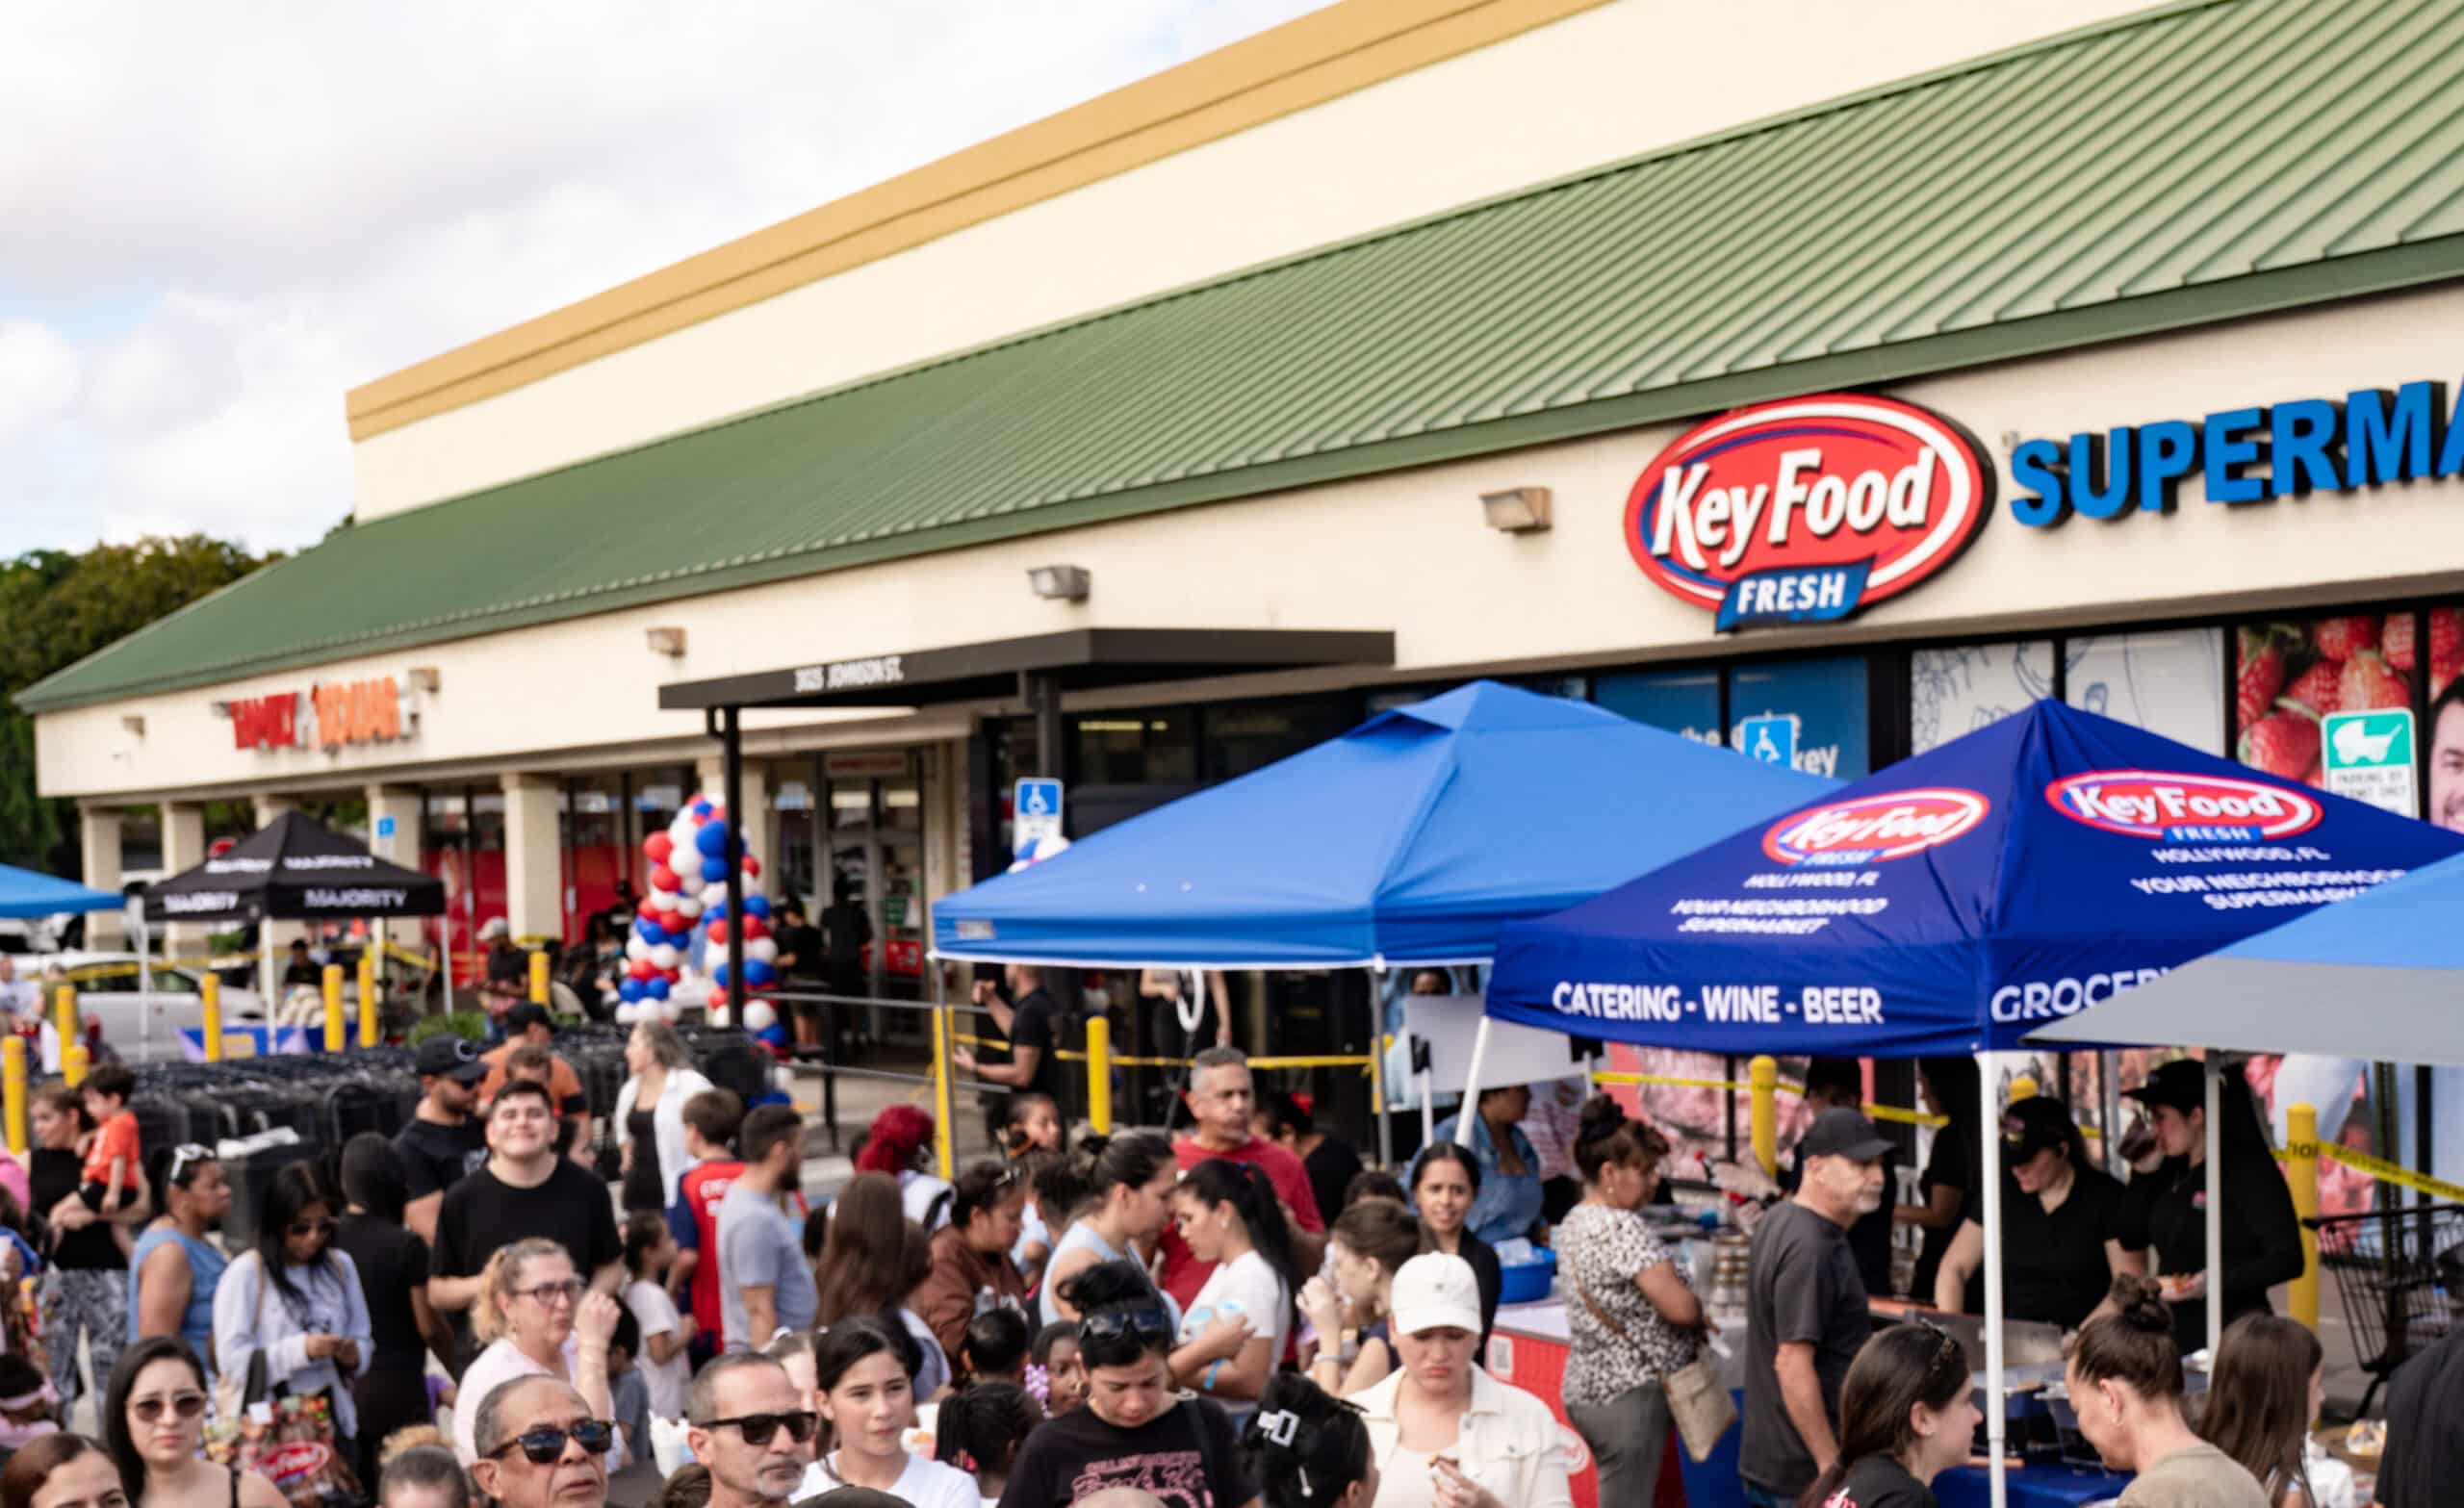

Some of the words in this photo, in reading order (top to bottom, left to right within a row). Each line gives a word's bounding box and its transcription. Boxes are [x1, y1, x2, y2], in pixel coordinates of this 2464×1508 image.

[1651, 462, 1770, 571] Key
[1767, 447, 1937, 546] Food
[1735, 572, 1847, 614] FRESH
[2067, 785, 2160, 823] Key
[2154, 787, 2286, 819] Food
[2172, 825, 2252, 842] FRESH
[304, 888, 407, 907] MAJORITY
[2130, 875, 2213, 896] YOUR
[2202, 885, 2369, 910] SUPERMARK
[1552, 981, 1681, 1022] CATERING
[1701, 984, 1781, 1023] WINE
[1802, 985, 1885, 1024] BEER
[1990, 966, 2171, 1023] GROCE
